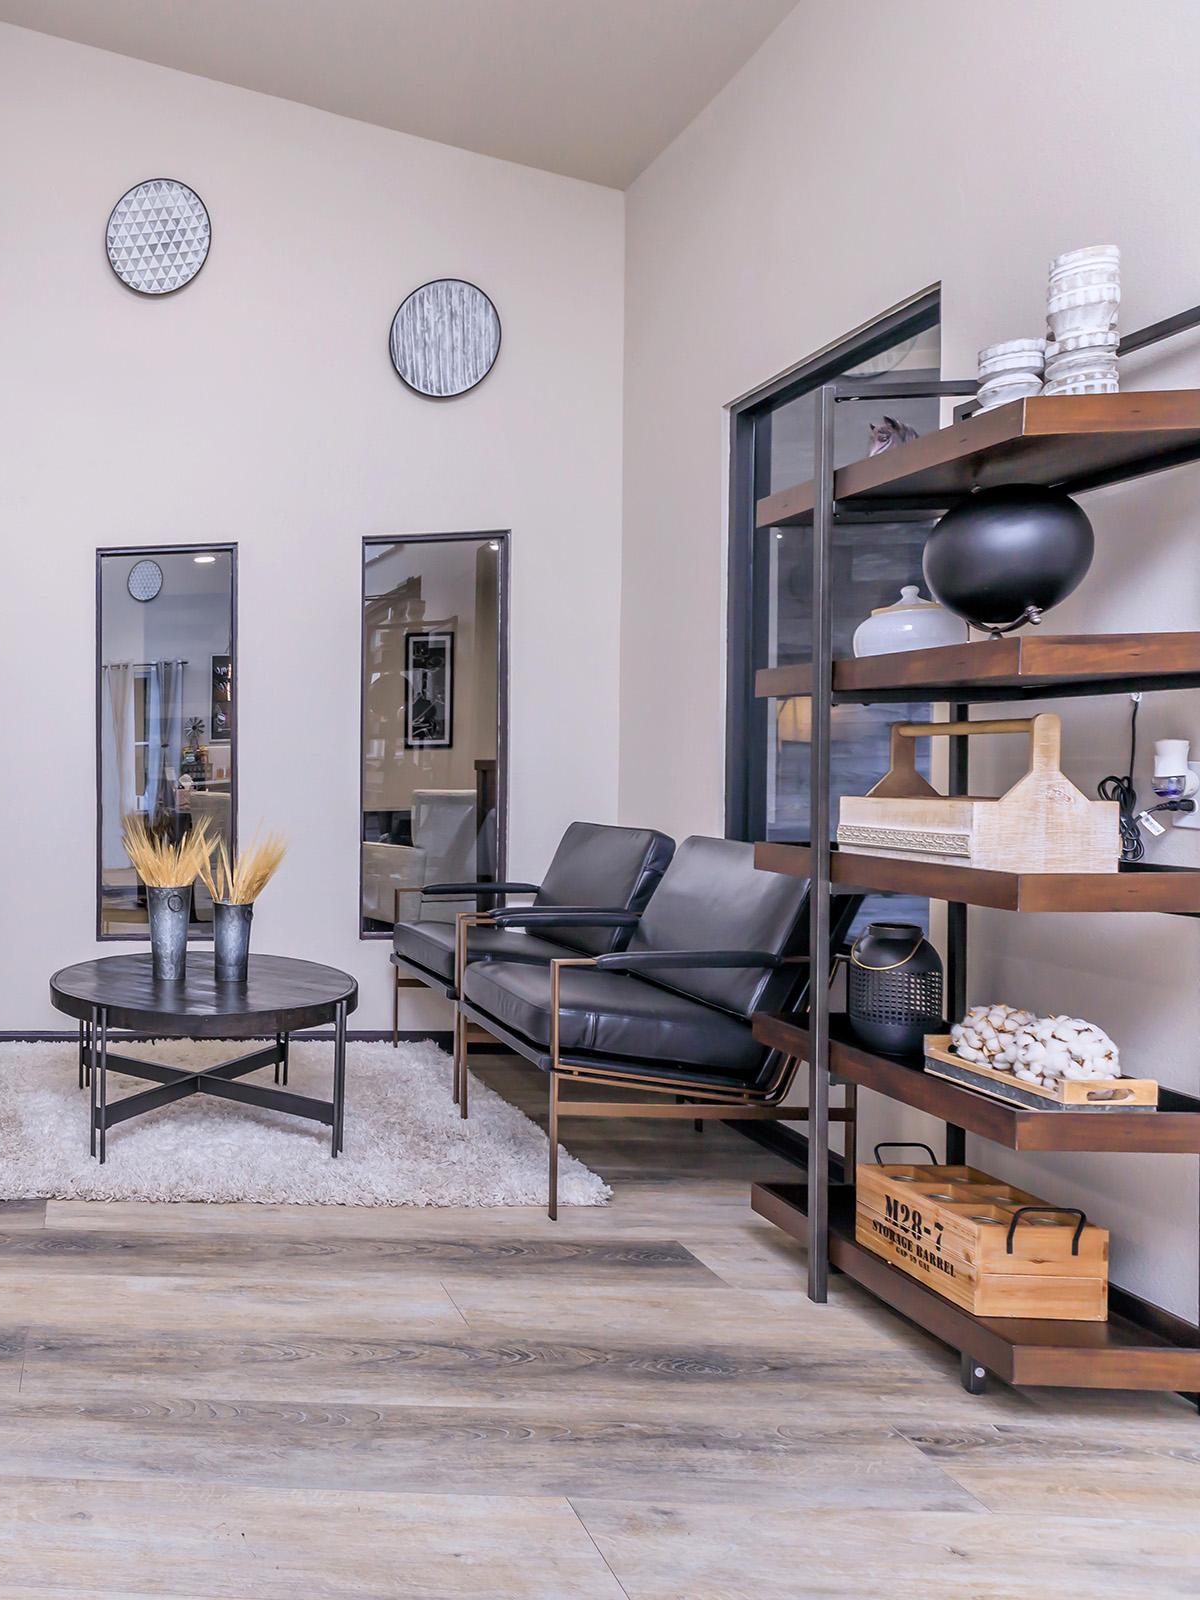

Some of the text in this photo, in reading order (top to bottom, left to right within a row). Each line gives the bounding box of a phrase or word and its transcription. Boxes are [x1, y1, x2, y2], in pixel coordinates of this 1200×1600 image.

[872, 1218, 956, 1278] STORAGE BARREL
[884, 1194, 944, 1252] M28-7
